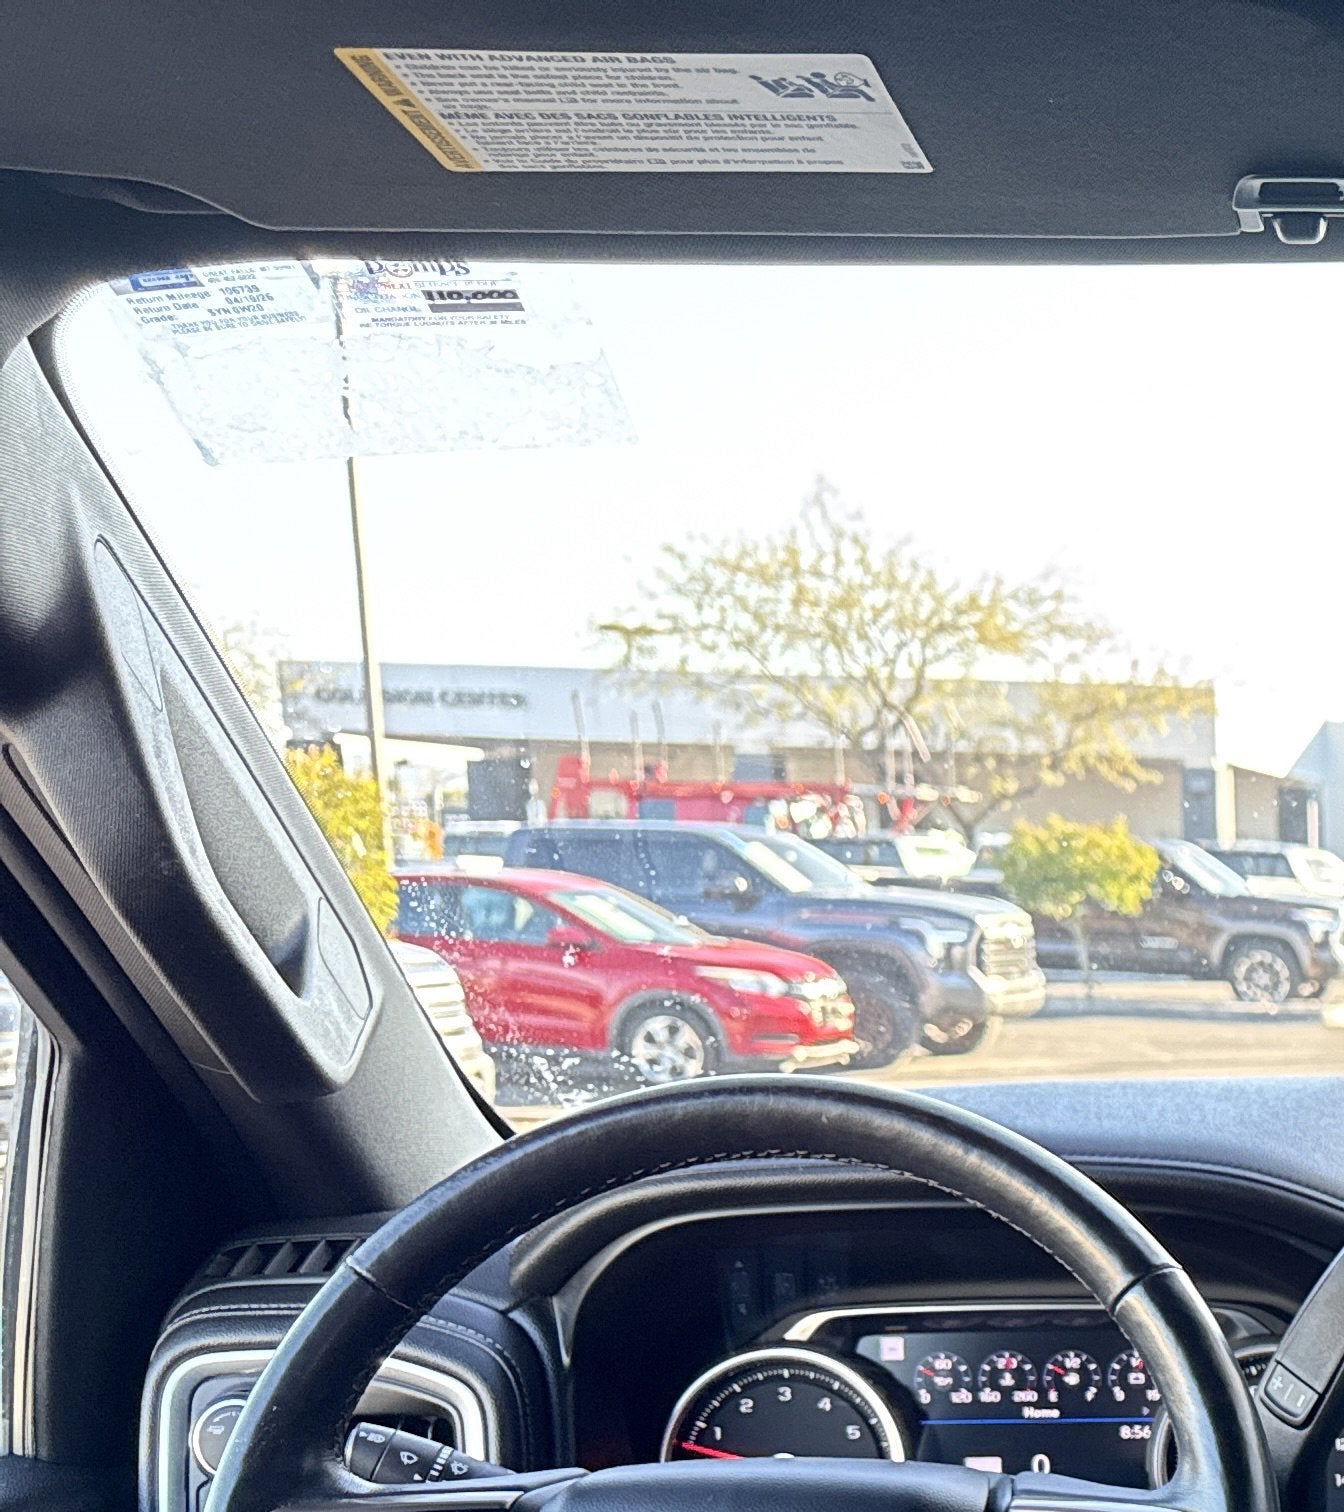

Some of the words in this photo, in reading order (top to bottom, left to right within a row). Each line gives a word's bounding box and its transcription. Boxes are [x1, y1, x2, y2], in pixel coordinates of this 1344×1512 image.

[383, 52, 432, 61] EVEN
[437, 53, 483, 62] WITH
[488, 54, 585, 63] ADVANCED
[592, 55, 622, 63] AIR
[777, 1386, 792, 1402] 3
[739, 1398, 754, 1414] 2
[817, 1397, 832, 1412] 4
[1022, 1406, 1060, 1419] Home
[713, 1426, 722, 1441] 1
[846, 1425, 861, 1440] 5
[1119, 1424, 1152, 1440] 8:56
[1031, 1454, 1050, 1475] 0
